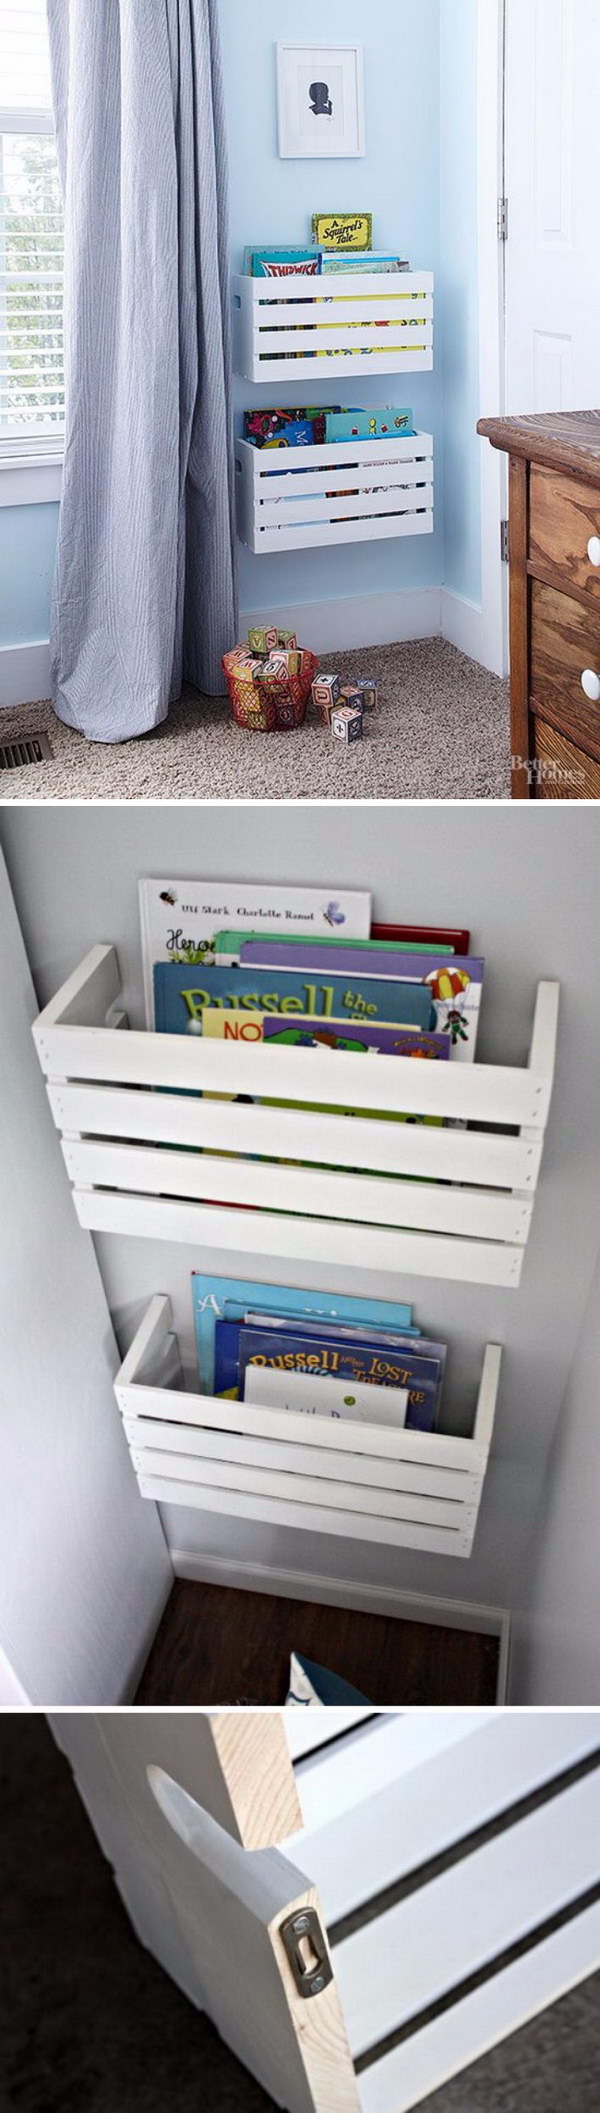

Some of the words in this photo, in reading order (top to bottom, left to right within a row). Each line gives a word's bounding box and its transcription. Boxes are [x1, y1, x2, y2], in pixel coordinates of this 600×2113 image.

[322, 219, 363, 240] Squirrel's
[331, 220, 340, 229] A
[268, 263, 318, 277] THIDWICK
[202, 906, 230, 916] Stark
[236, 907, 282, 919] Charlotte
[180, 984, 334, 1019] Russell
[344, 990, 377, 1015] the
[224, 1021, 263, 1042] NO
[367, 1357, 413, 1385] LOST
